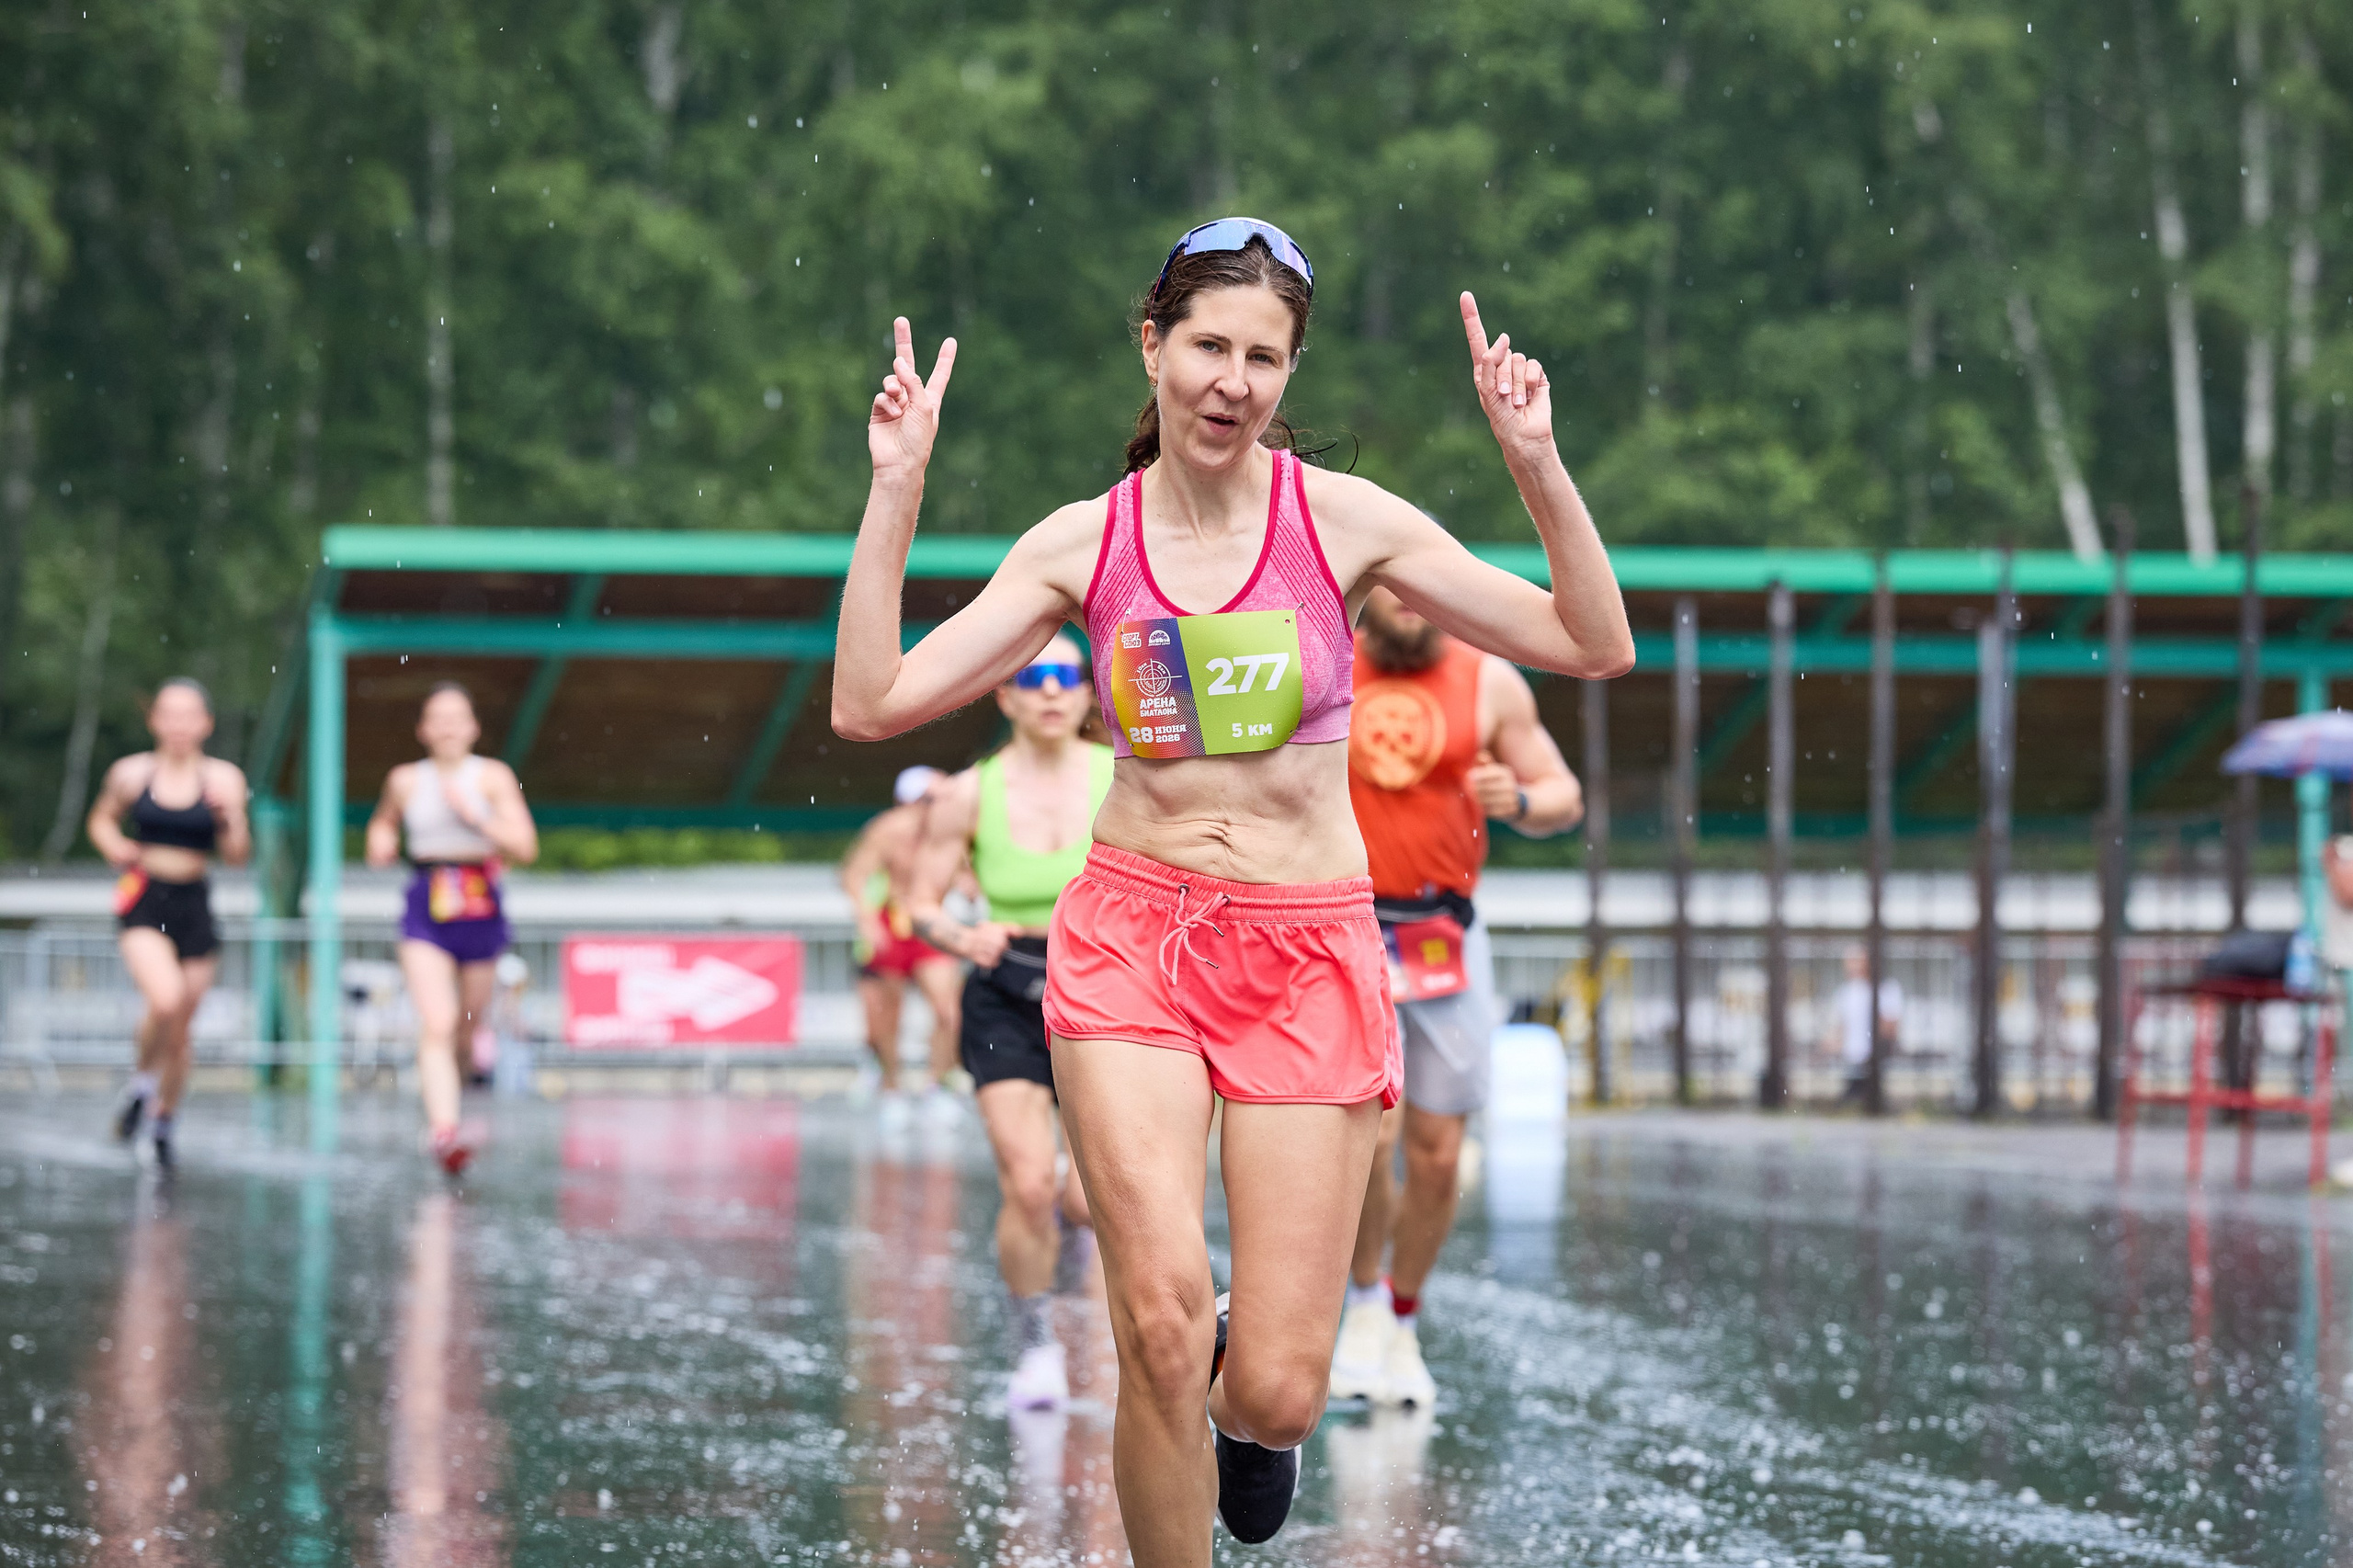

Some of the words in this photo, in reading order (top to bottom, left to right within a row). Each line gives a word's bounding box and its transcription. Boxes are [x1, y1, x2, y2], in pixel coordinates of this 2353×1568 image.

[1206, 653, 1289, 695] 277
[1140, 697, 1176, 710] АРЕНА
[1140, 707, 1177, 717] БИАТЛОНА
[1129, 726, 1154, 744] 28
[1155, 725, 1187, 734] ИЮНЯ
[1232, 722, 1243, 737] 5
[1155, 733, 1180, 743] 2026
